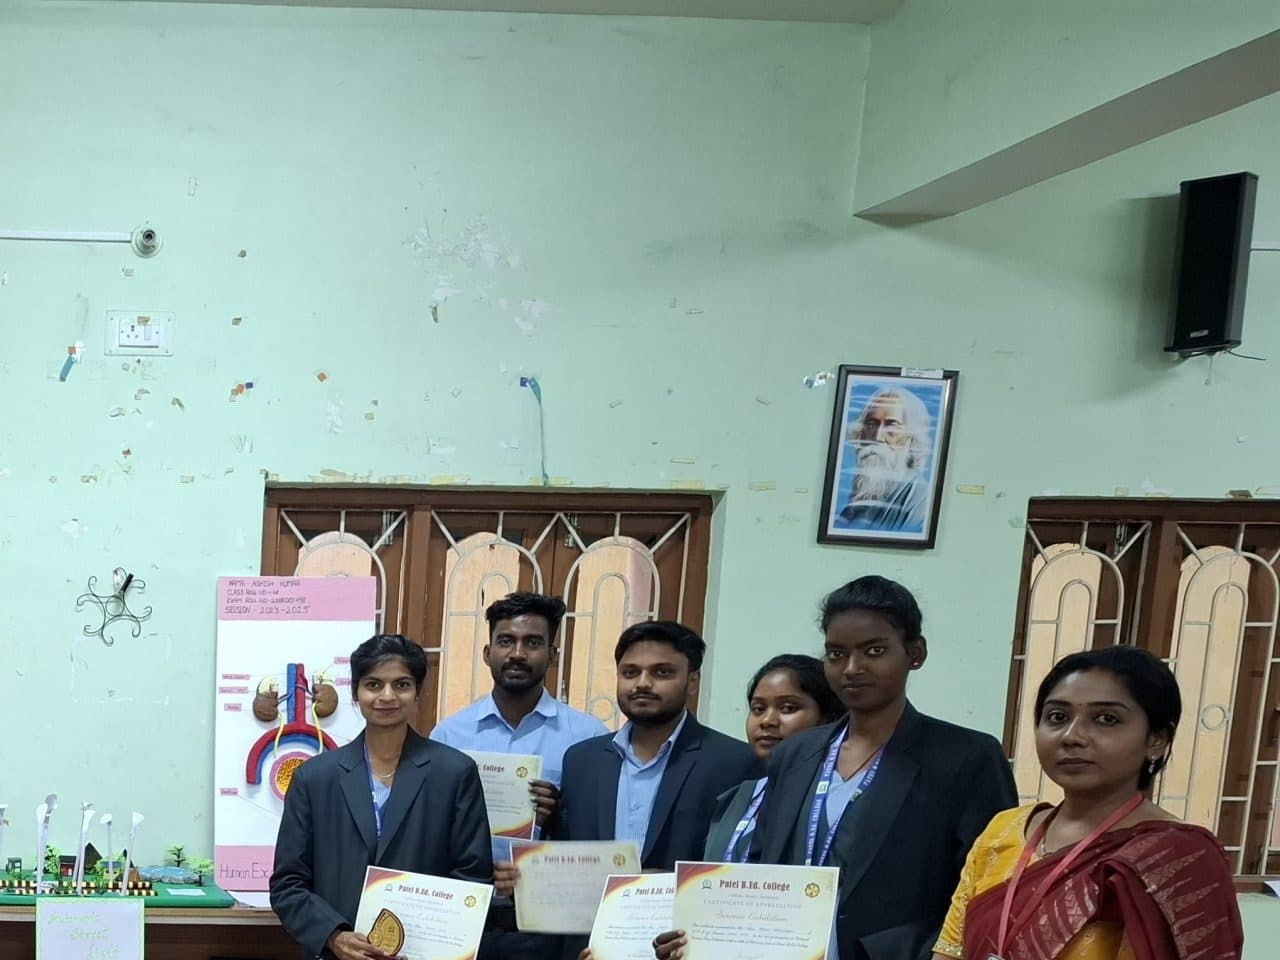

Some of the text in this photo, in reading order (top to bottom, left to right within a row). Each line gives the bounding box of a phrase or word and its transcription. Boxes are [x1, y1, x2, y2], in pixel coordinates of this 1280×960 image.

[482, 764, 505, 773] College
[220, 863, 250, 879] Human
[398, 884, 414, 893] Patel
[431, 889, 454, 900] College
[719, 879, 791, 892] Patel B.Ed. College
